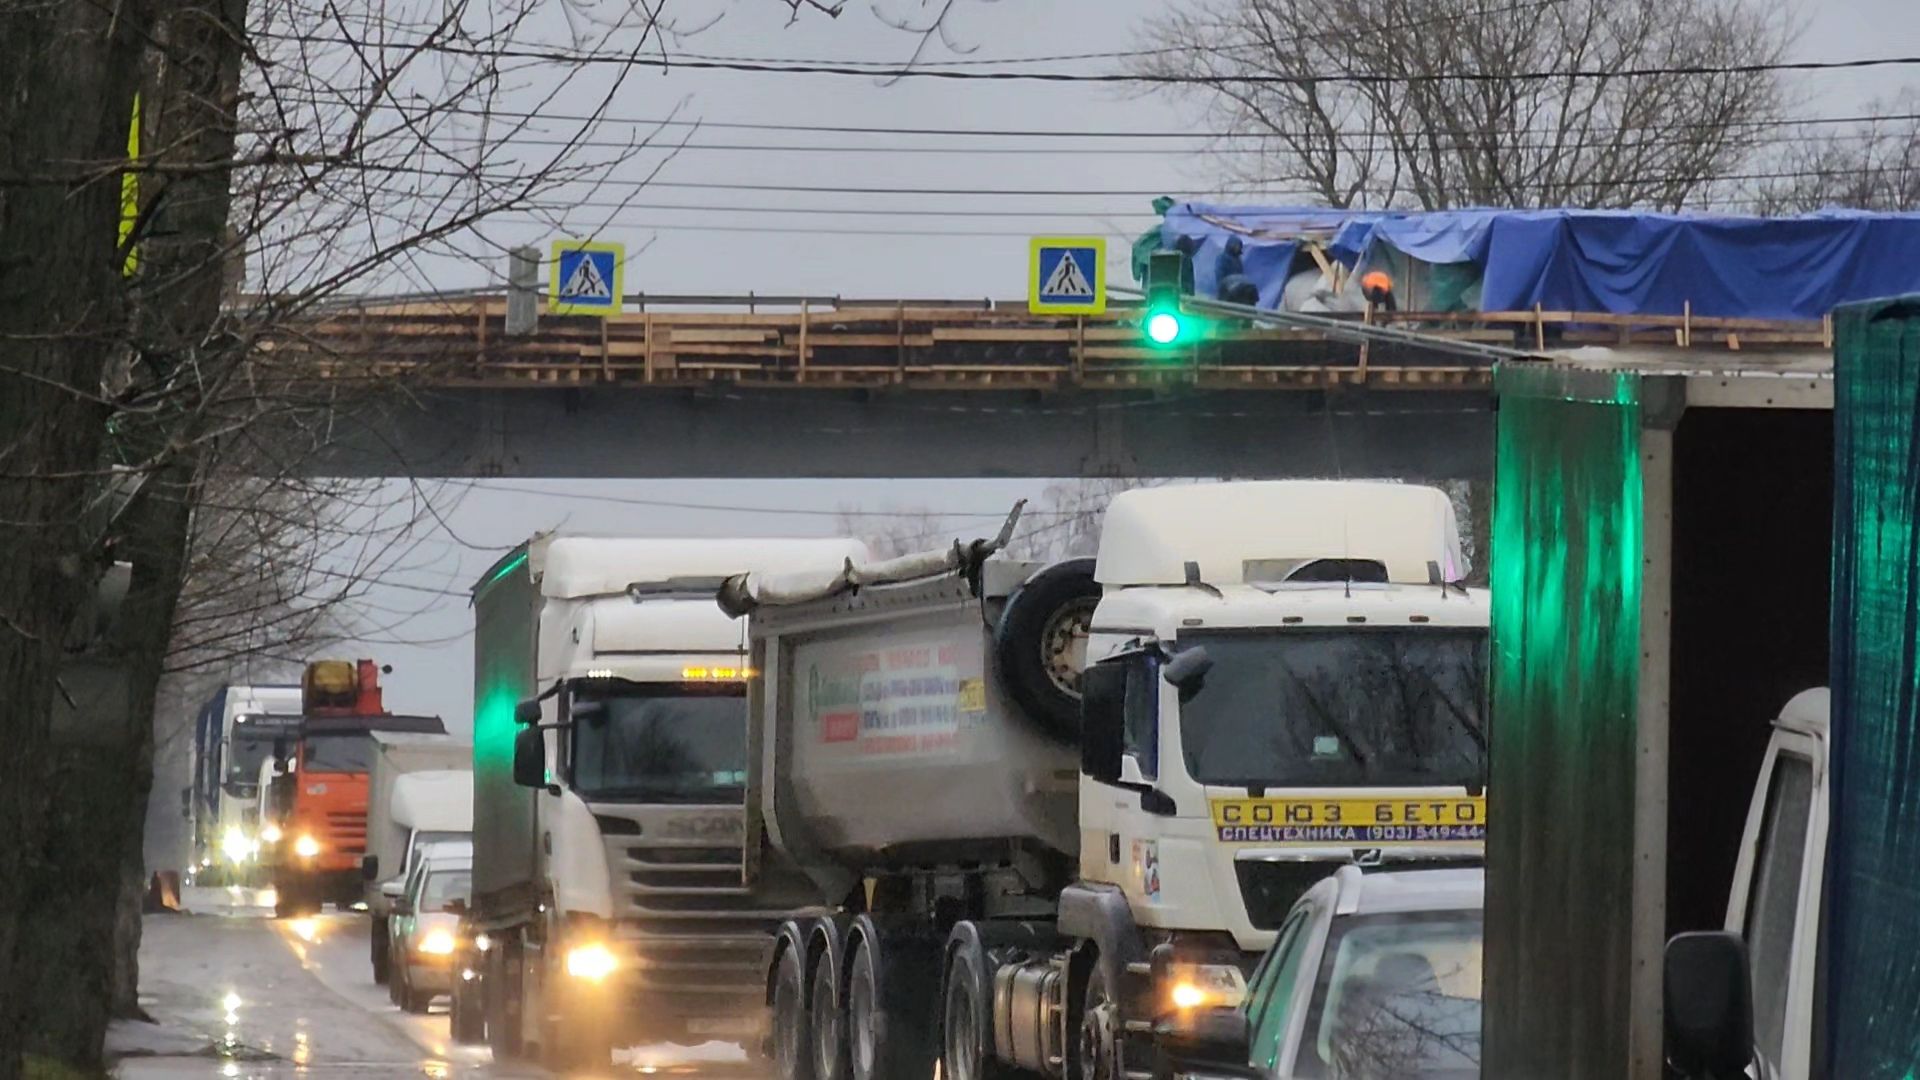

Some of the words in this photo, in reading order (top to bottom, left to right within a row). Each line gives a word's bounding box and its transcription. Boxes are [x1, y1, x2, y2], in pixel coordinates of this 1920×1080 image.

[1222, 804, 1342, 823] СОЮЗ
[1375, 804, 1475, 823] БЕТО
[1222, 825, 1356, 841] СПЕЦТЕХНИКА
[1366, 825, 1412, 841] (903)
